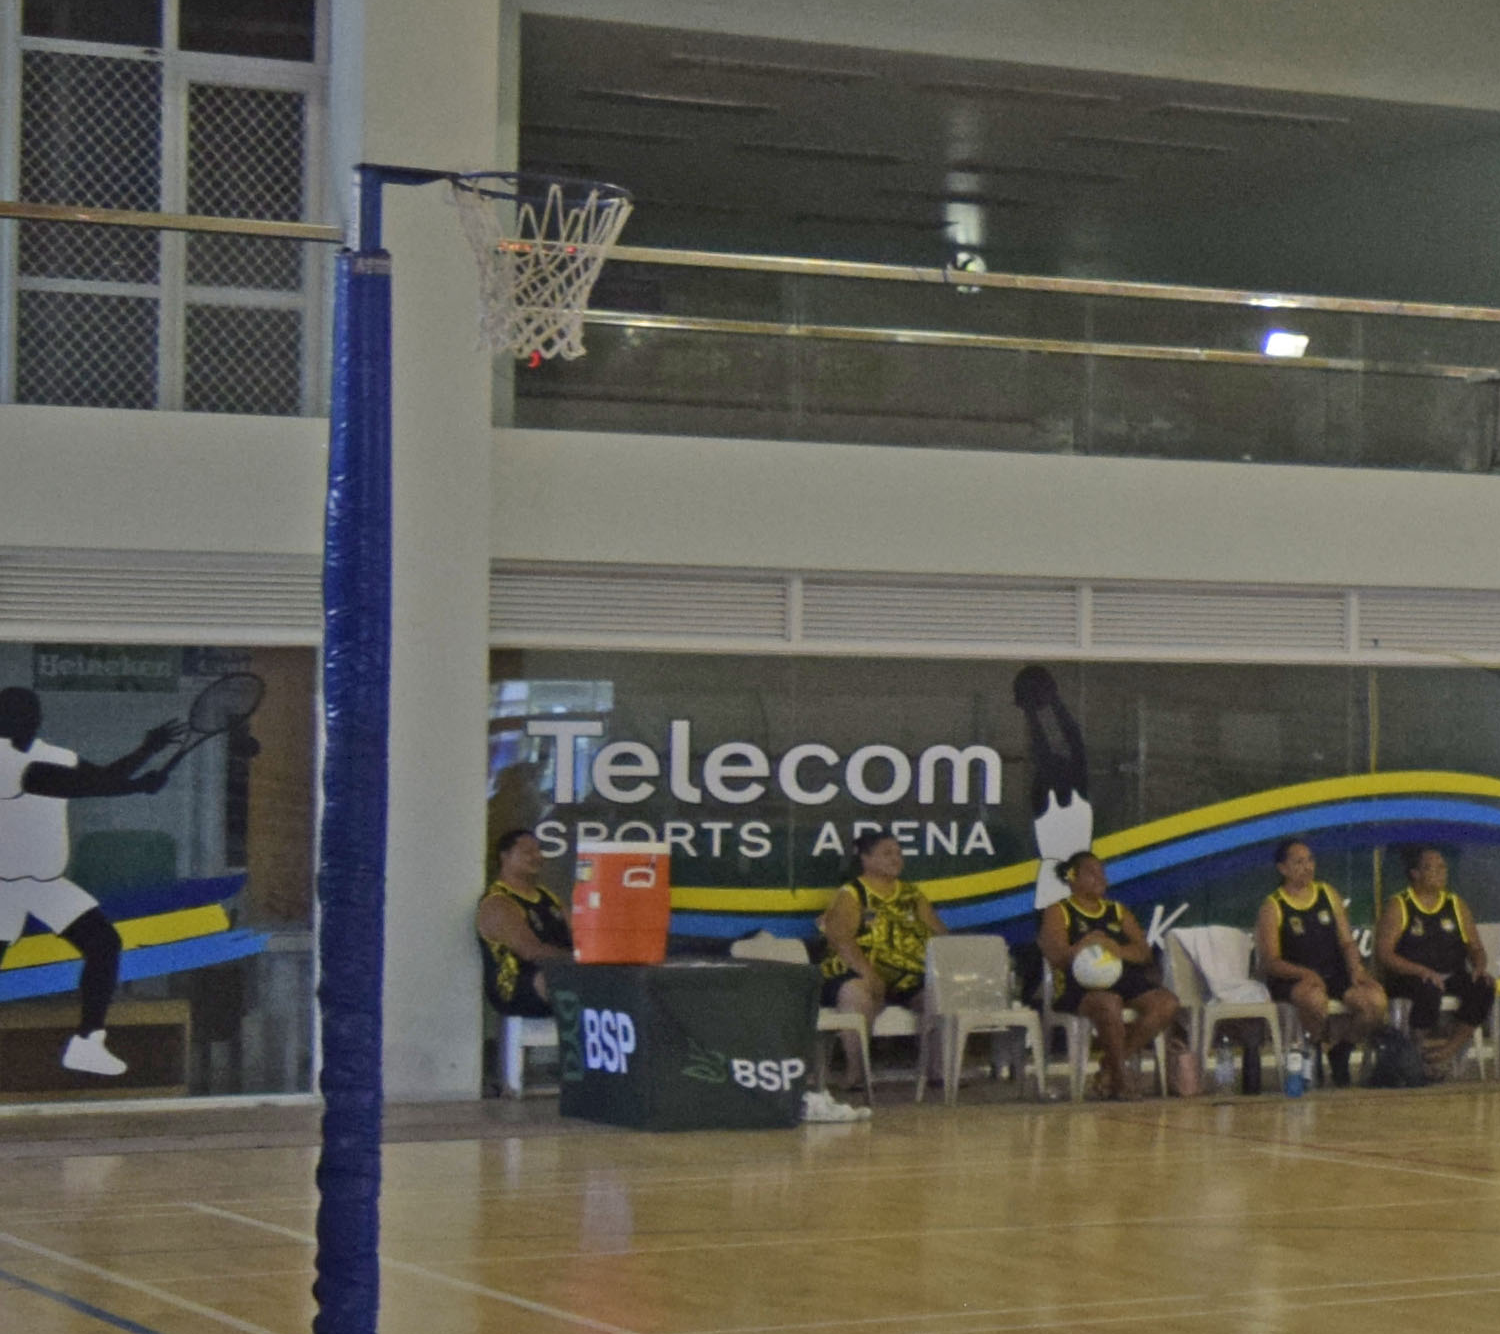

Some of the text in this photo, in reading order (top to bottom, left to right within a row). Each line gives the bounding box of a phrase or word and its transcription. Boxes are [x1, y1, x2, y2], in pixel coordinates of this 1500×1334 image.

[526, 719, 1002, 805] Telecom
[582, 1007, 637, 1075] BSP
[730, 1057, 806, 1092] BSP
